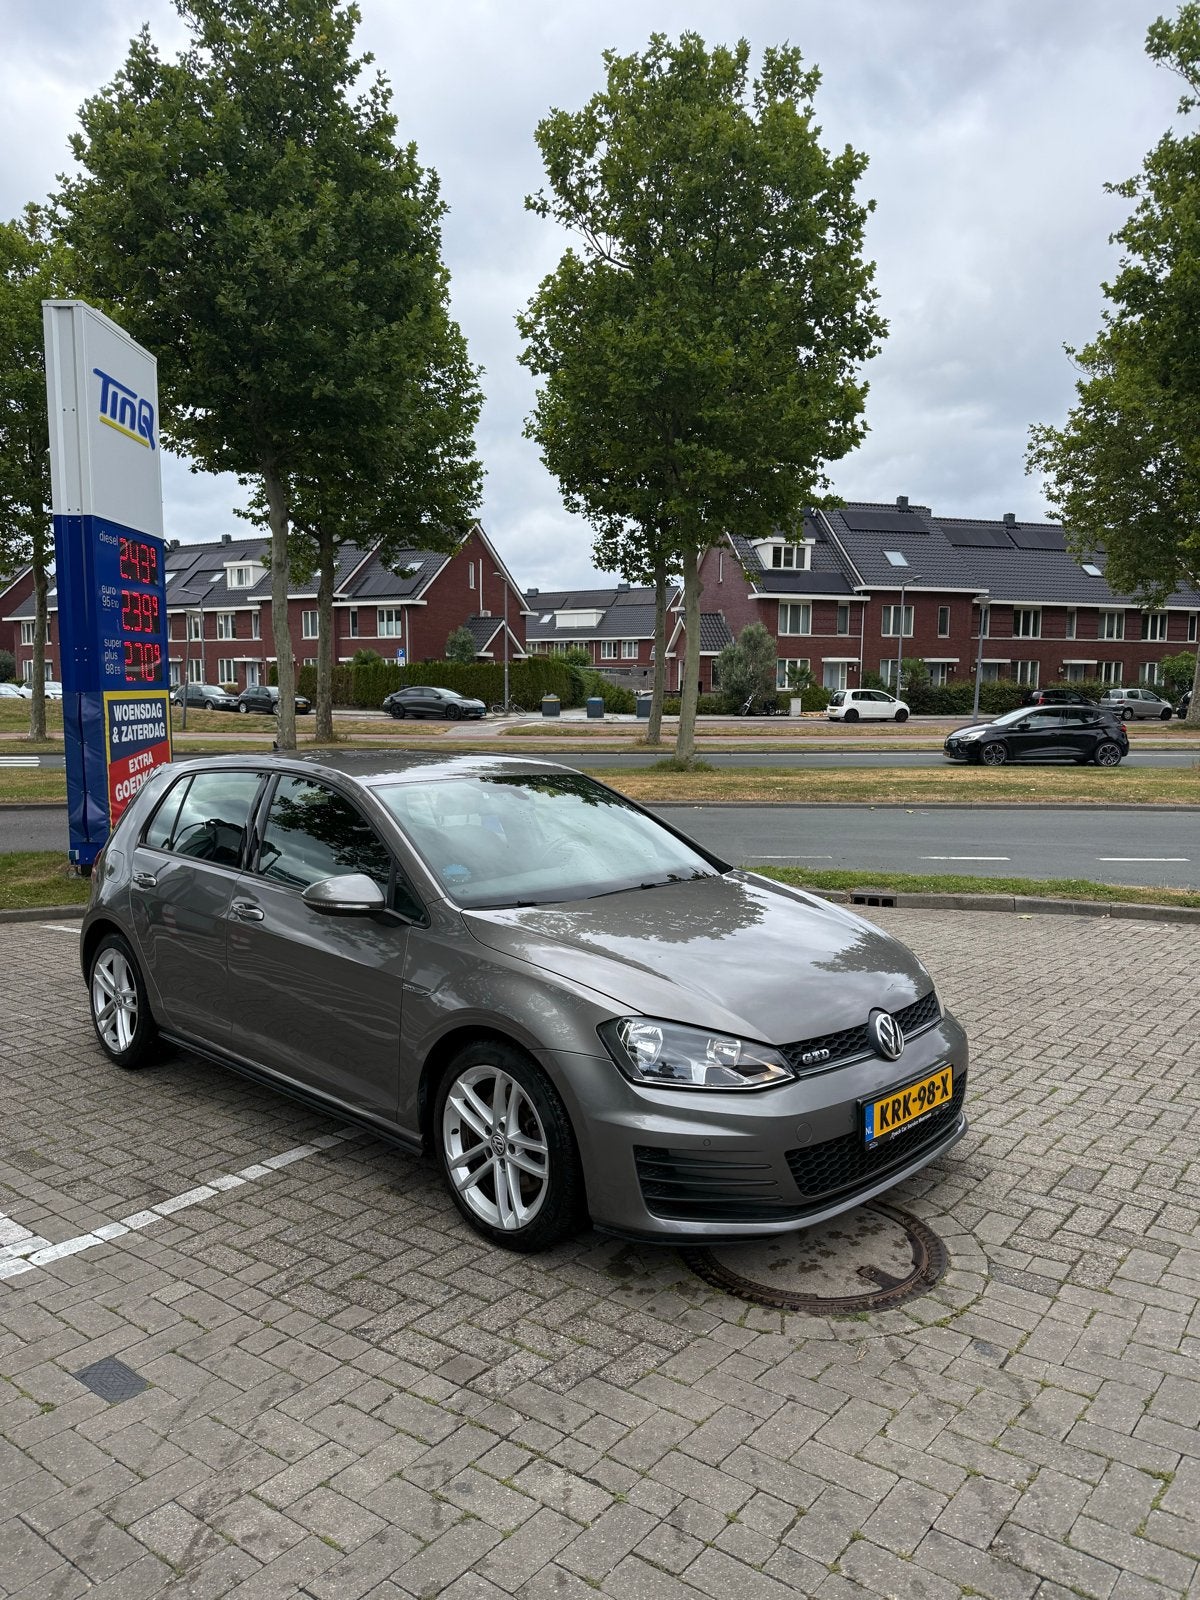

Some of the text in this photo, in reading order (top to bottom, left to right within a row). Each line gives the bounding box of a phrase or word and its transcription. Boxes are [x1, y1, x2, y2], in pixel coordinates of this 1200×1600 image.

[99, 531, 118, 546] diesel
[102, 585, 116, 595] euro
[102, 595, 119, 609] 95 E10
[104, 638, 121, 650] super
[104, 649, 118, 662] plus
[105, 663, 114, 675] 98
[113, 703, 162, 721] WOENSDAG
[112, 722, 165, 743] & ZATERDAG
[128, 751, 153, 774] EXTRA
[802, 1048, 830, 1064] GTD
[879, 1073, 949, 1130] KRK-98-X
[865, 1126, 872, 1136] NL
